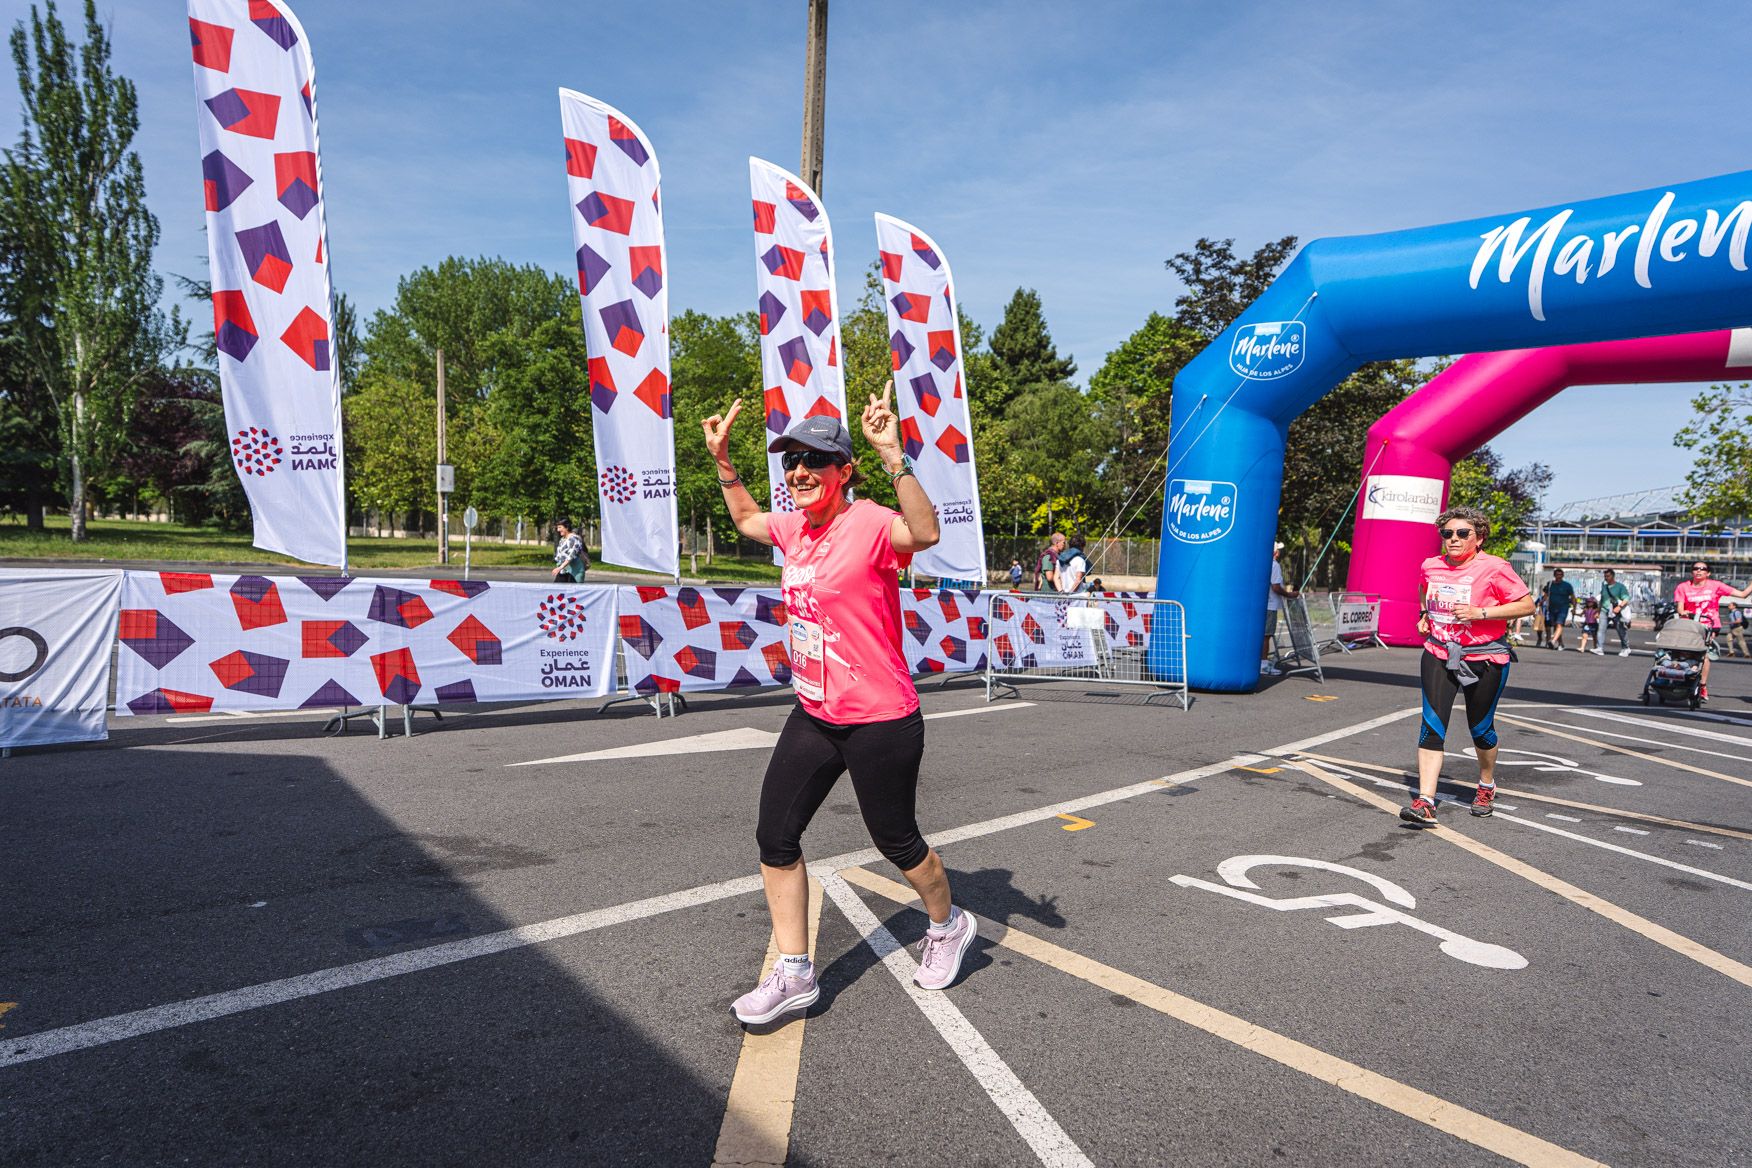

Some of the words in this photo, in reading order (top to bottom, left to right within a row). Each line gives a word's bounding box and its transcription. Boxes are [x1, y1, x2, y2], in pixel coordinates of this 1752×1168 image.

[1235, 335, 1299, 365] Marlene
[1273, 363, 1293, 375] ALPES
[1382, 490, 1439, 506] kirolaraba
[1170, 494, 1229, 525] Marlene
[1179, 530, 1187, 538] DE
[1188, 532, 1200, 540] LOS
[1201, 527, 1222, 539] ALPES
[1342, 612, 1349, 624] EL
[1351, 611, 1373, 623] CORREO
[540, 649, 589, 658] Experience
[793, 651, 807, 668] 016
[541, 675, 591, 688] OMAN
[0, 697, 43, 708] TATA
